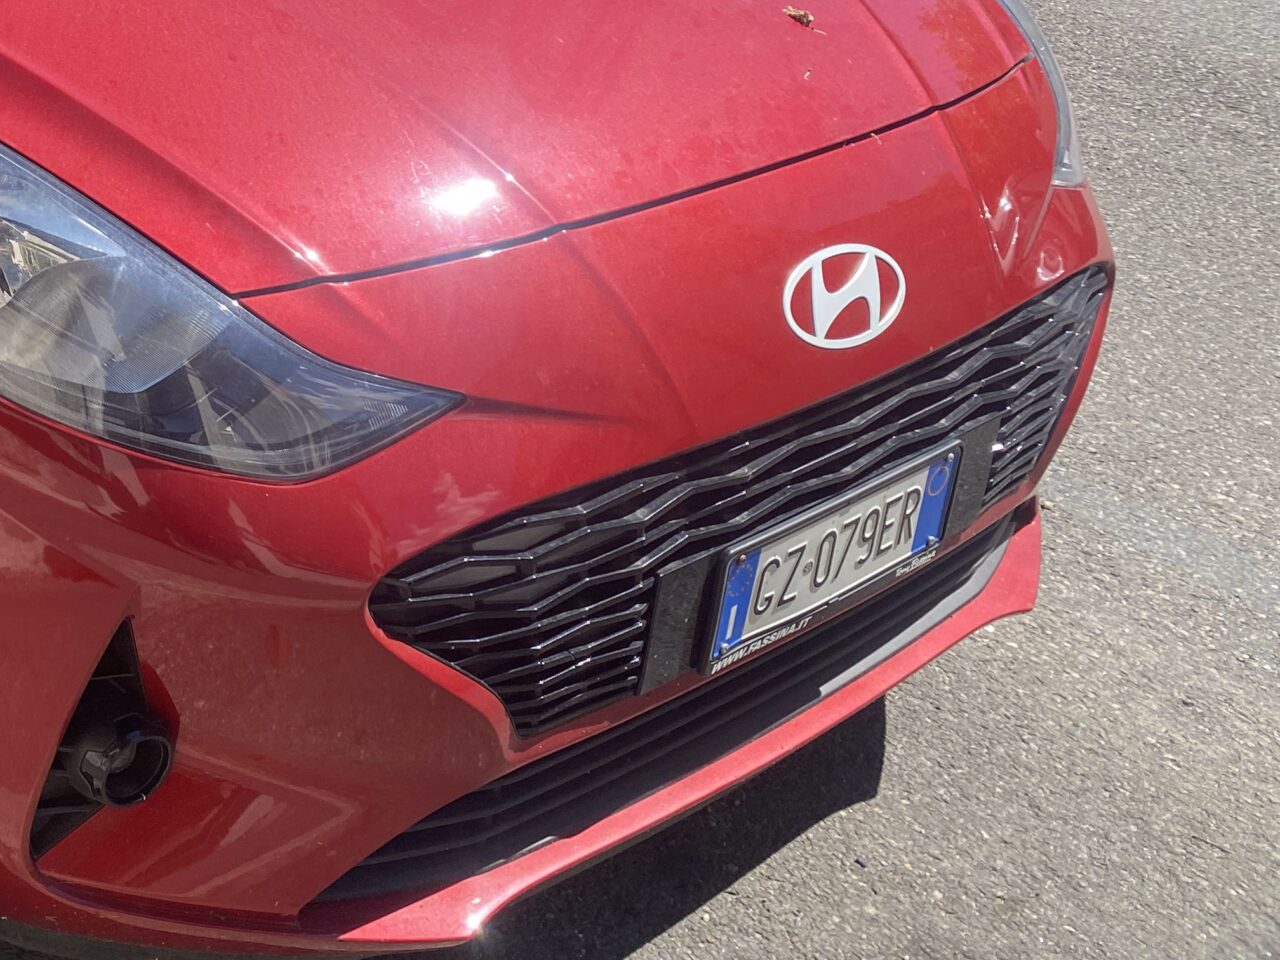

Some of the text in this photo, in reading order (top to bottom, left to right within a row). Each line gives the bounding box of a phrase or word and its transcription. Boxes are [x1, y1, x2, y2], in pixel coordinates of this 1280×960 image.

[753, 543, 809, 617] GZ
[812, 485, 923, 589] 079ER
[711, 615, 813, 675] WWW.FASSINA.IT
